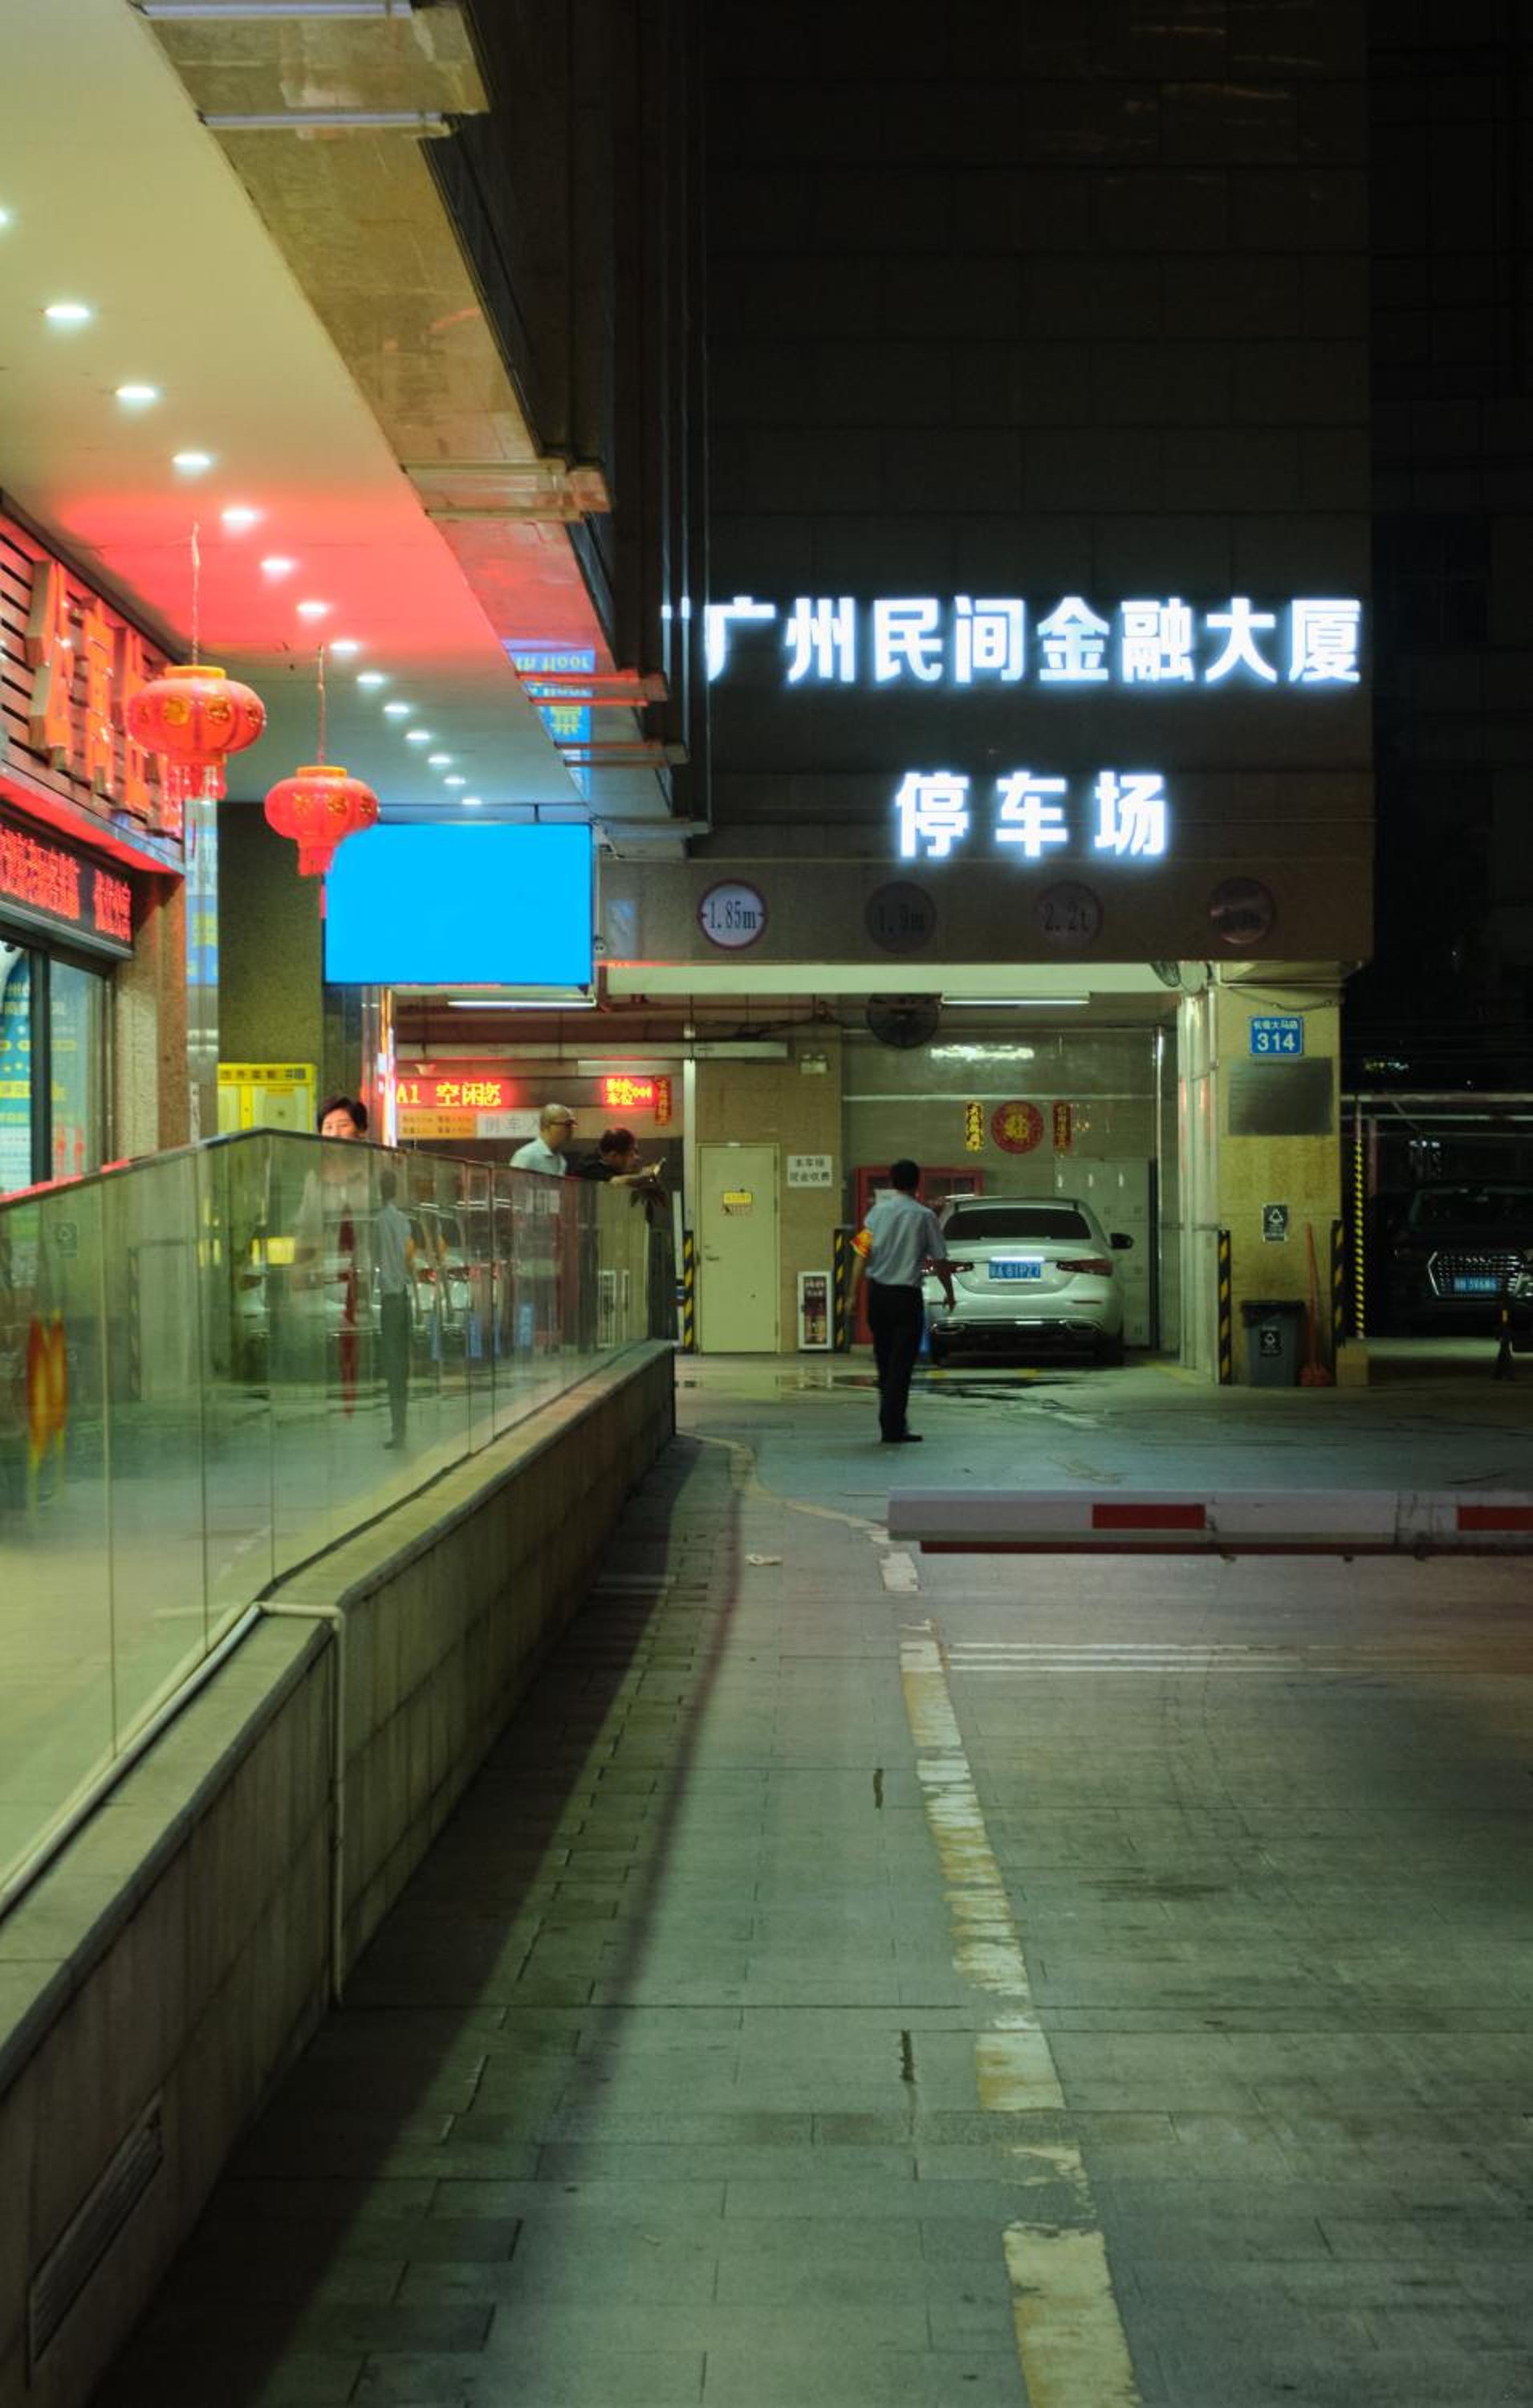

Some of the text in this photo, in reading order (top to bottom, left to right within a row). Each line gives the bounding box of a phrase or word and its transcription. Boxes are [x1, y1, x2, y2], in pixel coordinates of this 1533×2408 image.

[703, 596, 1361, 683] 广州民间金融大厦
[893, 769, 1168, 858] 停车场
[710, 900, 758, 929] 1.85m
[1257, 1032, 1295, 1052] 314
